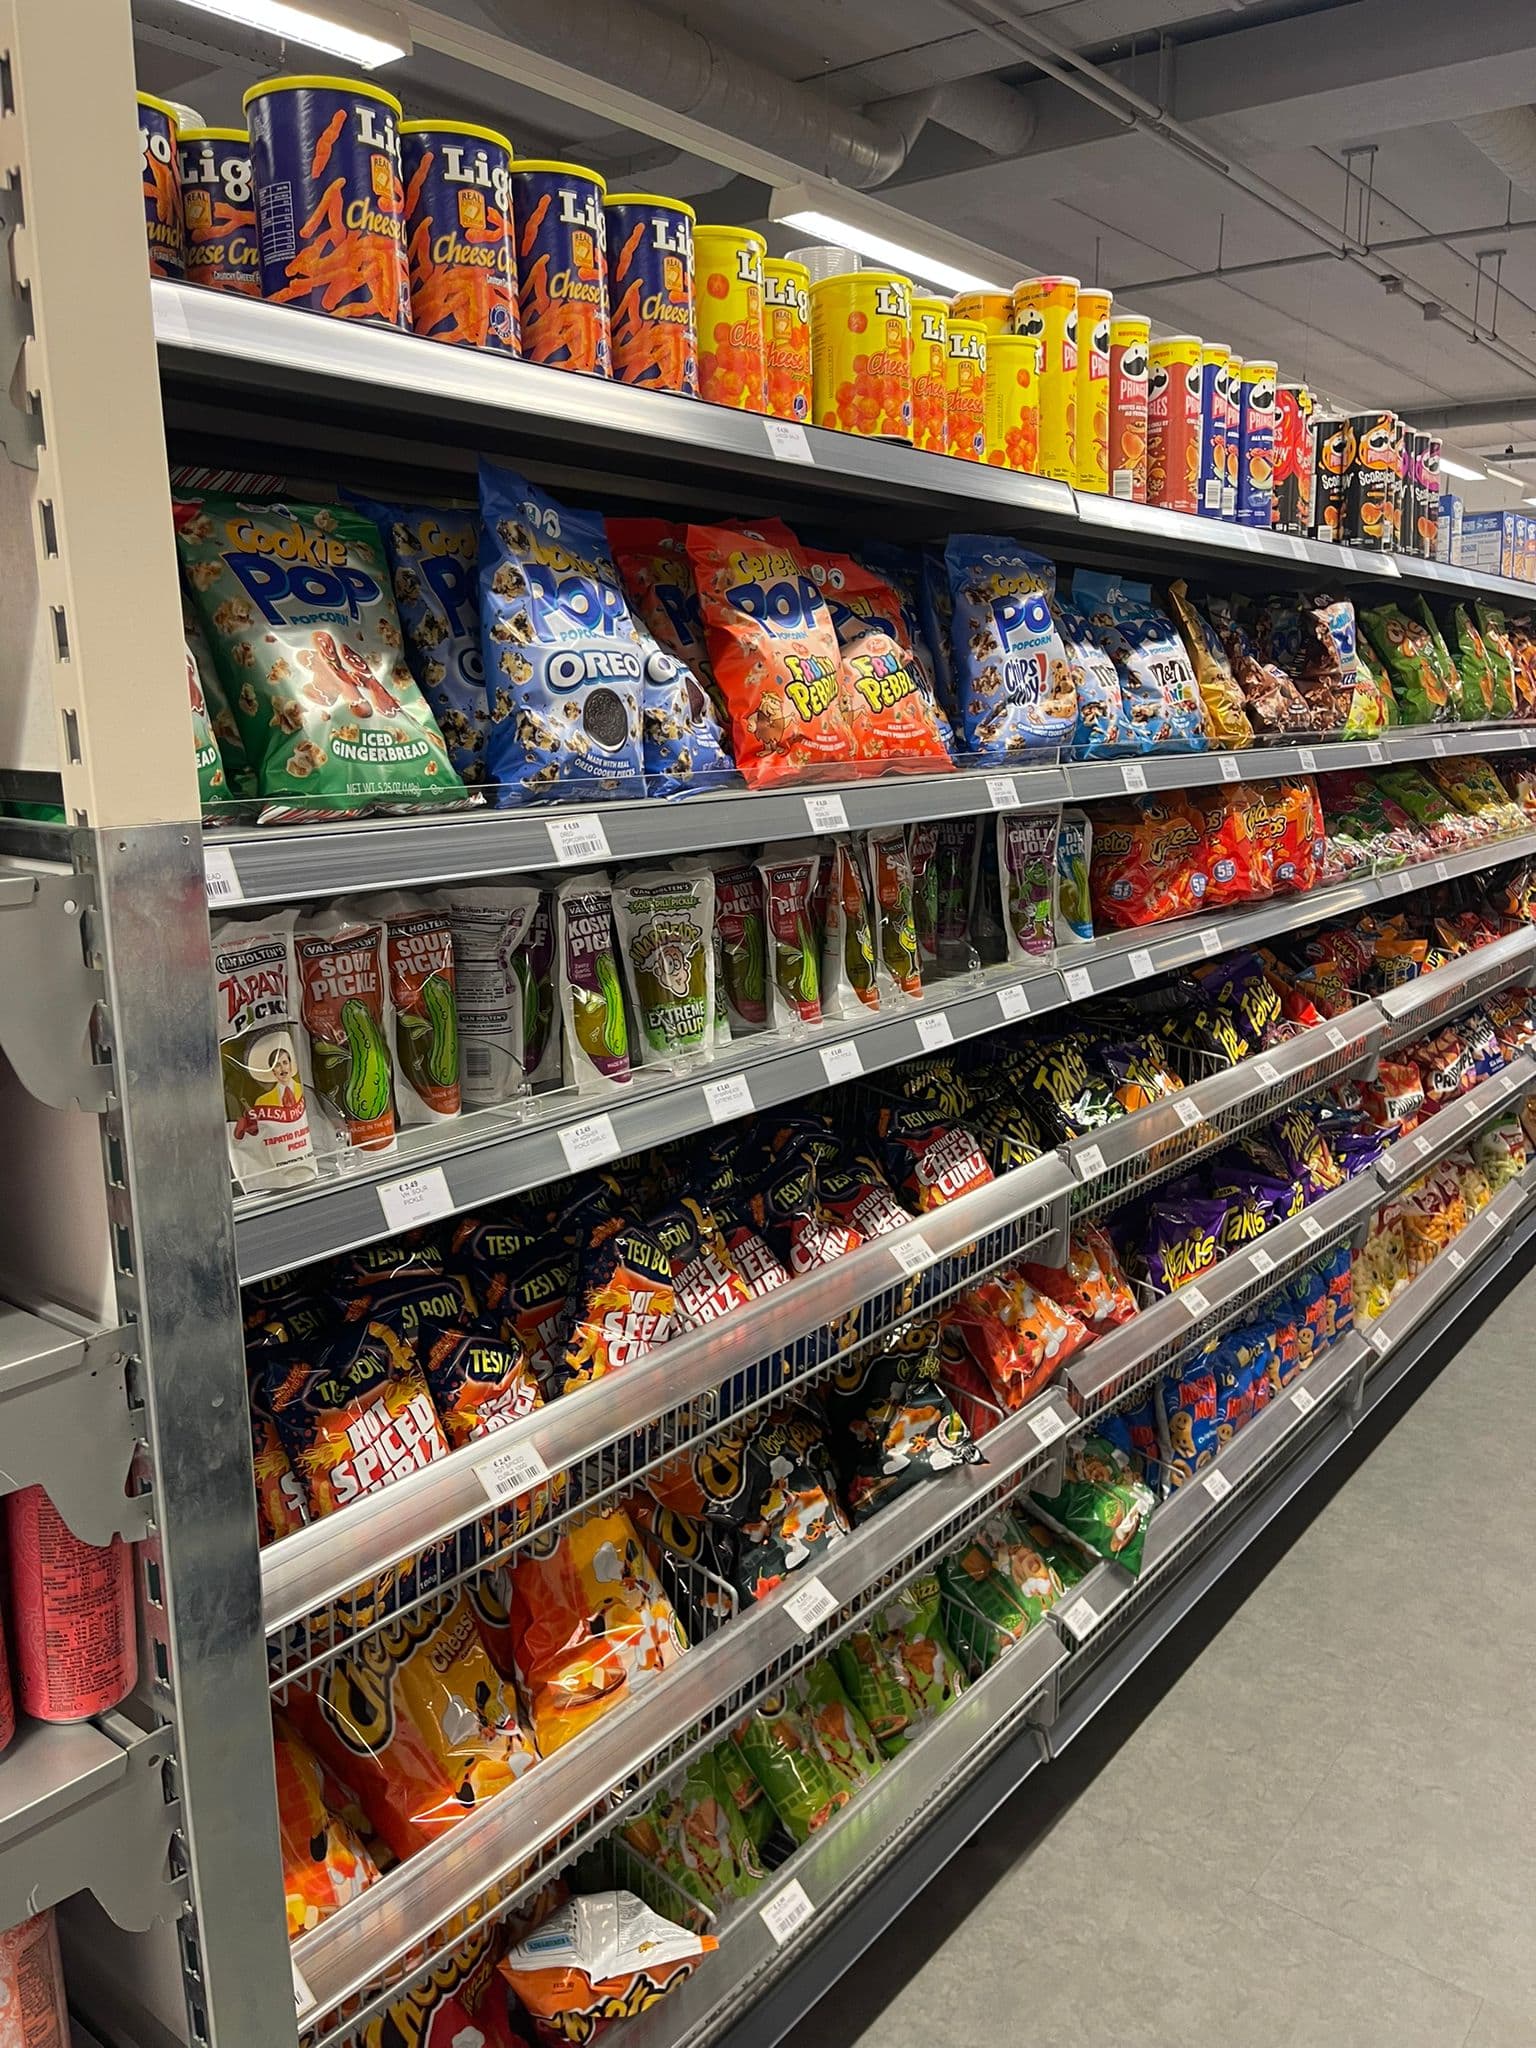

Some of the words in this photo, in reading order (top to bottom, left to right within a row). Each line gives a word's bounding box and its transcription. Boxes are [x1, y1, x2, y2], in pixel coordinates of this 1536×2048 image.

[433, 231, 496, 267] Cheese
[224, 518, 348, 567] Cookie
[728, 549, 799, 585] Cereal
[219, 551, 384, 629] POP
[520, 561, 626, 643] POP
[289, 613, 351, 627] POPCORN
[725, 575, 825, 639] POP
[1012, 634, 1052, 651] POPCORN
[546, 651, 641, 692] OREO
[332, 739, 429, 763] GINGERBREAD
[362, 732, 393, 747] ICED
[346, 783, 363, 795] NET
[1020, 841, 1049, 855] JOE
[238, 946, 286, 966] HOLTEN'S
[307, 945, 334, 956] VAN
[318, 953, 372, 979] SOUR
[310, 972, 377, 1002] PICKLE
[649, 1000, 706, 1029] EXTREME
[664, 1017, 705, 1043] SOUR
[247, 1107, 288, 1121] SALSA
[924, 1126, 963, 1156] CRUNCHY
[937, 1150, 988, 1197] CURLZ
[346, 1396, 394, 1454] HOT
[331, 1393, 435, 1505] SPICED
